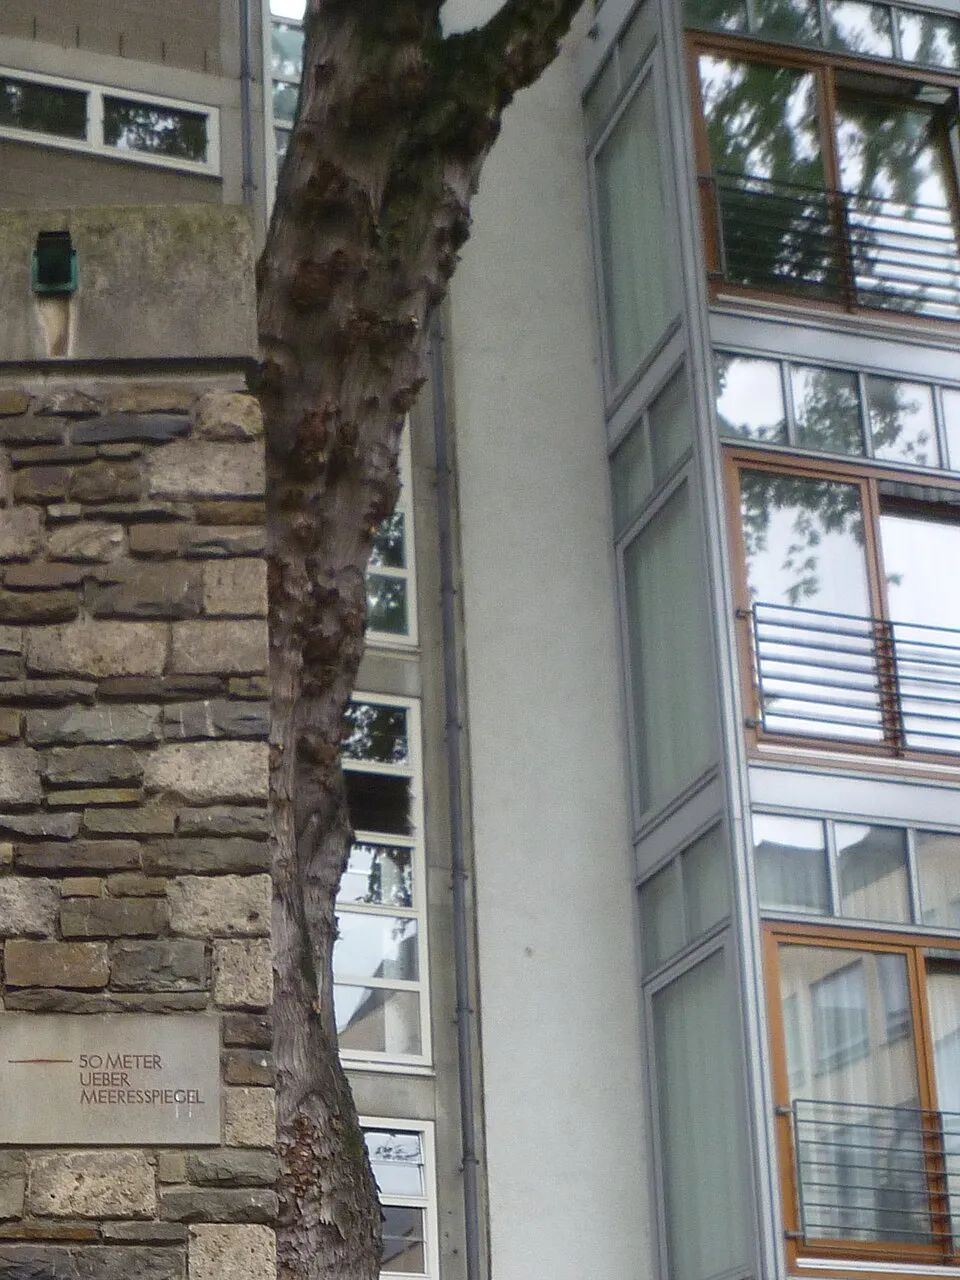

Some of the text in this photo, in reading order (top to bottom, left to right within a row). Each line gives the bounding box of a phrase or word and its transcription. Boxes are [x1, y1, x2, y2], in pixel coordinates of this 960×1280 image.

[79, 1055, 162, 1070] 50 METER
[80, 1072, 131, 1087] UEBER
[80, 1089, 205, 1105] MEERESSPIEGEL
